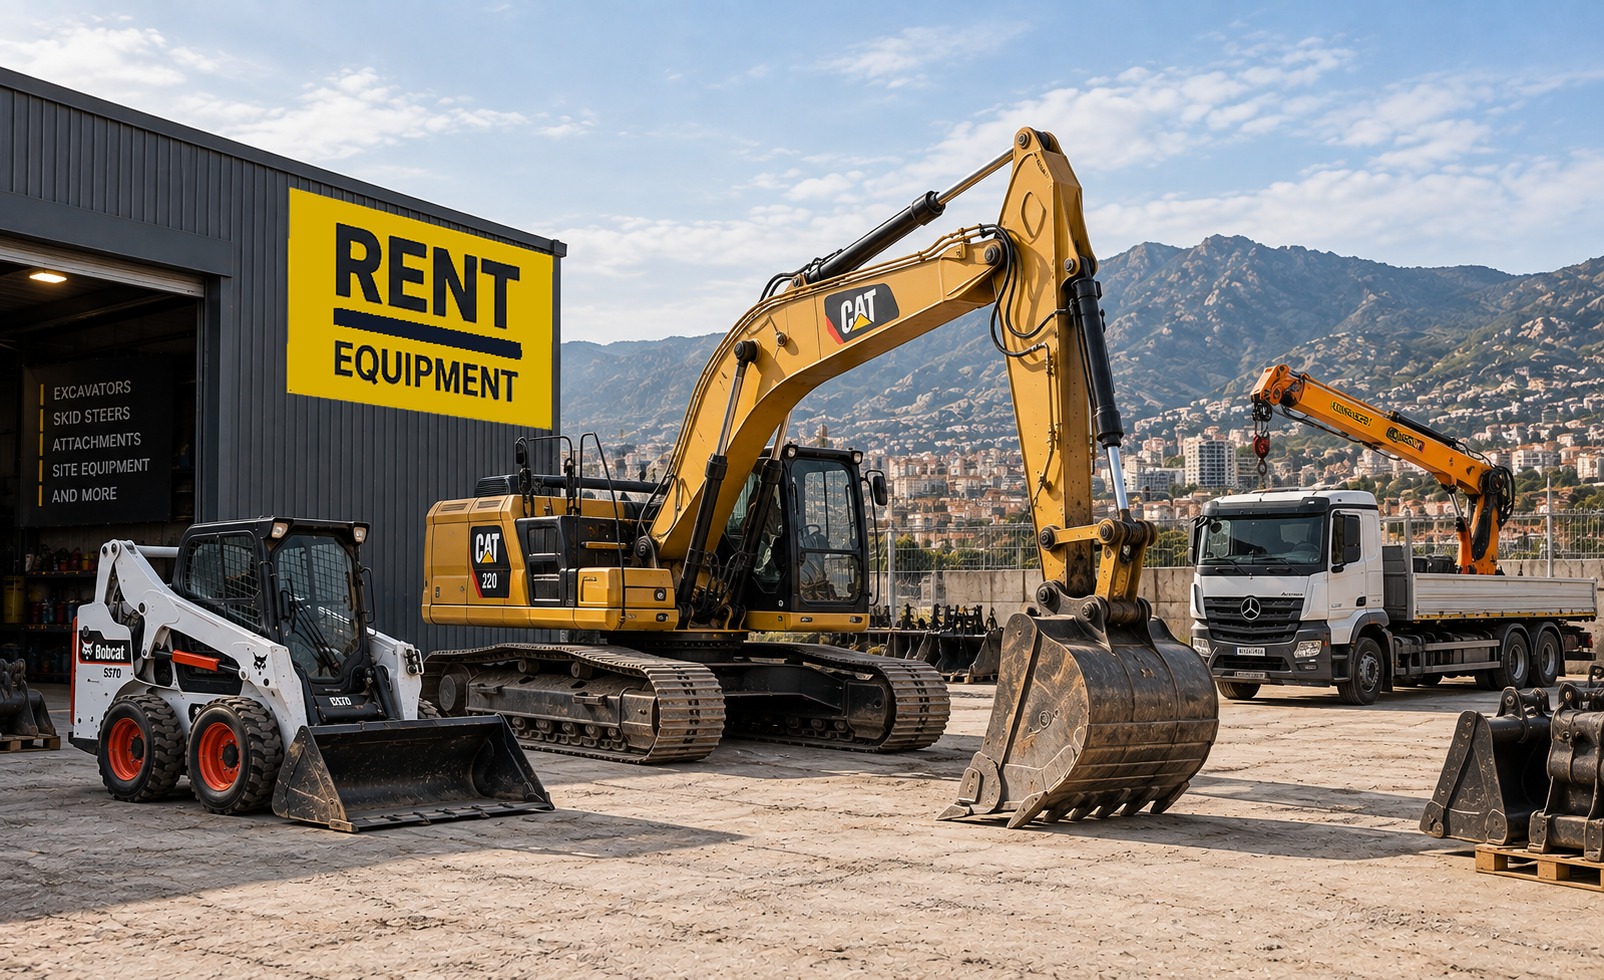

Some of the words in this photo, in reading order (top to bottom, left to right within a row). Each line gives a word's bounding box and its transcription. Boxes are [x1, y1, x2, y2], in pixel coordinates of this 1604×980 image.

[336, 222, 520, 329] RENT
[840, 287, 877, 334] CAT
[334, 340, 519, 402] EQUIPMENT
[53, 380, 131, 400] EXCAVATORS
[53, 410, 81, 426] SKID
[84, 406, 131, 424] STEERS
[52, 432, 142, 452] ATTACHMENTS
[52, 463, 78, 478] SITE
[81, 458, 150, 477] EQUIPMENT
[51, 489, 78, 503] AND
[81, 486, 118, 502] MORE
[475, 533, 500, 564] CAT
[482, 572, 498, 589] 220
[95, 644, 125, 660] Bobcat
